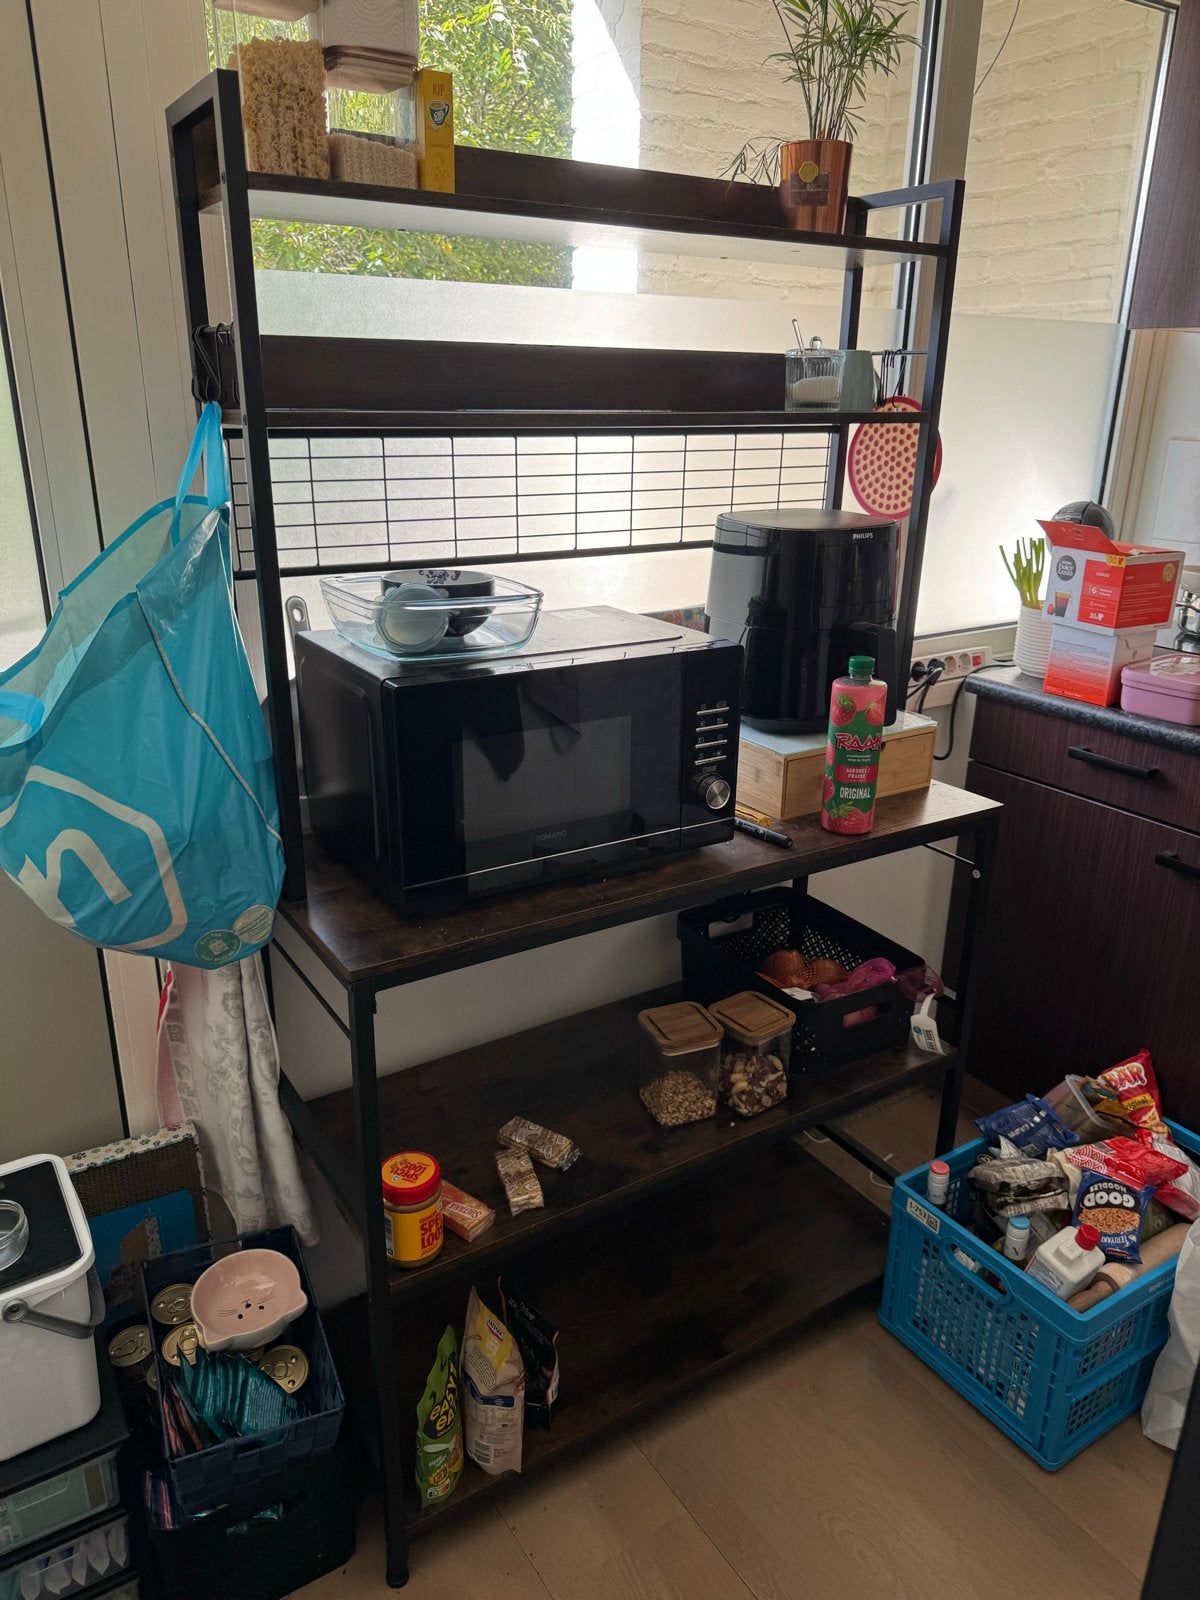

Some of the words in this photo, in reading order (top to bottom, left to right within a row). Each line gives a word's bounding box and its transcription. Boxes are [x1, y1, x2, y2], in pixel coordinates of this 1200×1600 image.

[432, 83, 445, 96] KIP
[852, 532, 874, 540] PHILIPS
[839, 787, 871, 799] ORIGINAL
[536, 830, 567, 841] TOMADO
[1089, 1182, 1127, 1193] NOODLES
[1083, 1191, 1135, 1208] GOOD
[1101, 1236, 1128, 1244] TERIYAKI
